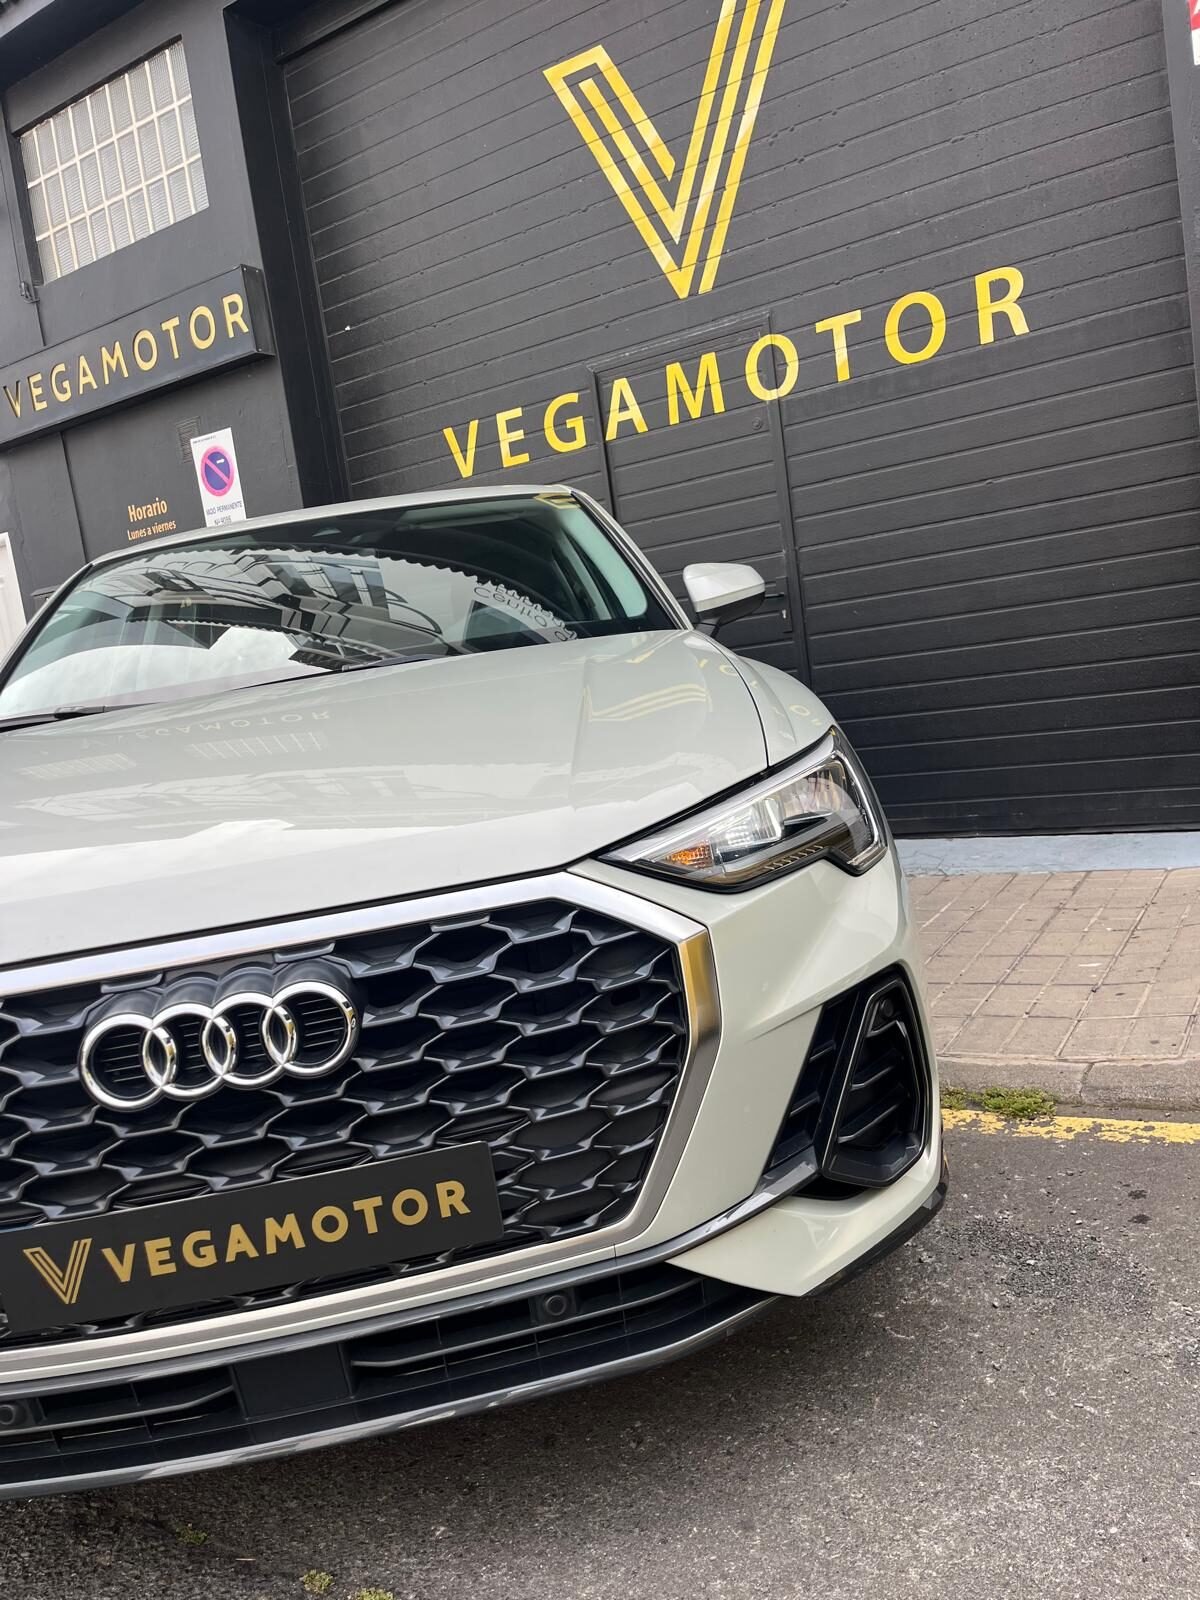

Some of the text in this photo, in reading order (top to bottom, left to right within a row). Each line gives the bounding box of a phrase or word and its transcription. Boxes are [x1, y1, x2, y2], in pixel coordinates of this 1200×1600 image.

[3, 293, 249, 419] VEGAMOTOR
[442, 266, 1030, 479] VEGAMOTOR
[127, 496, 168, 522] Horario
[127, 520, 177, 541] Lunes a viernes
[101, 1180, 471, 1283] VEGAMOTOR
